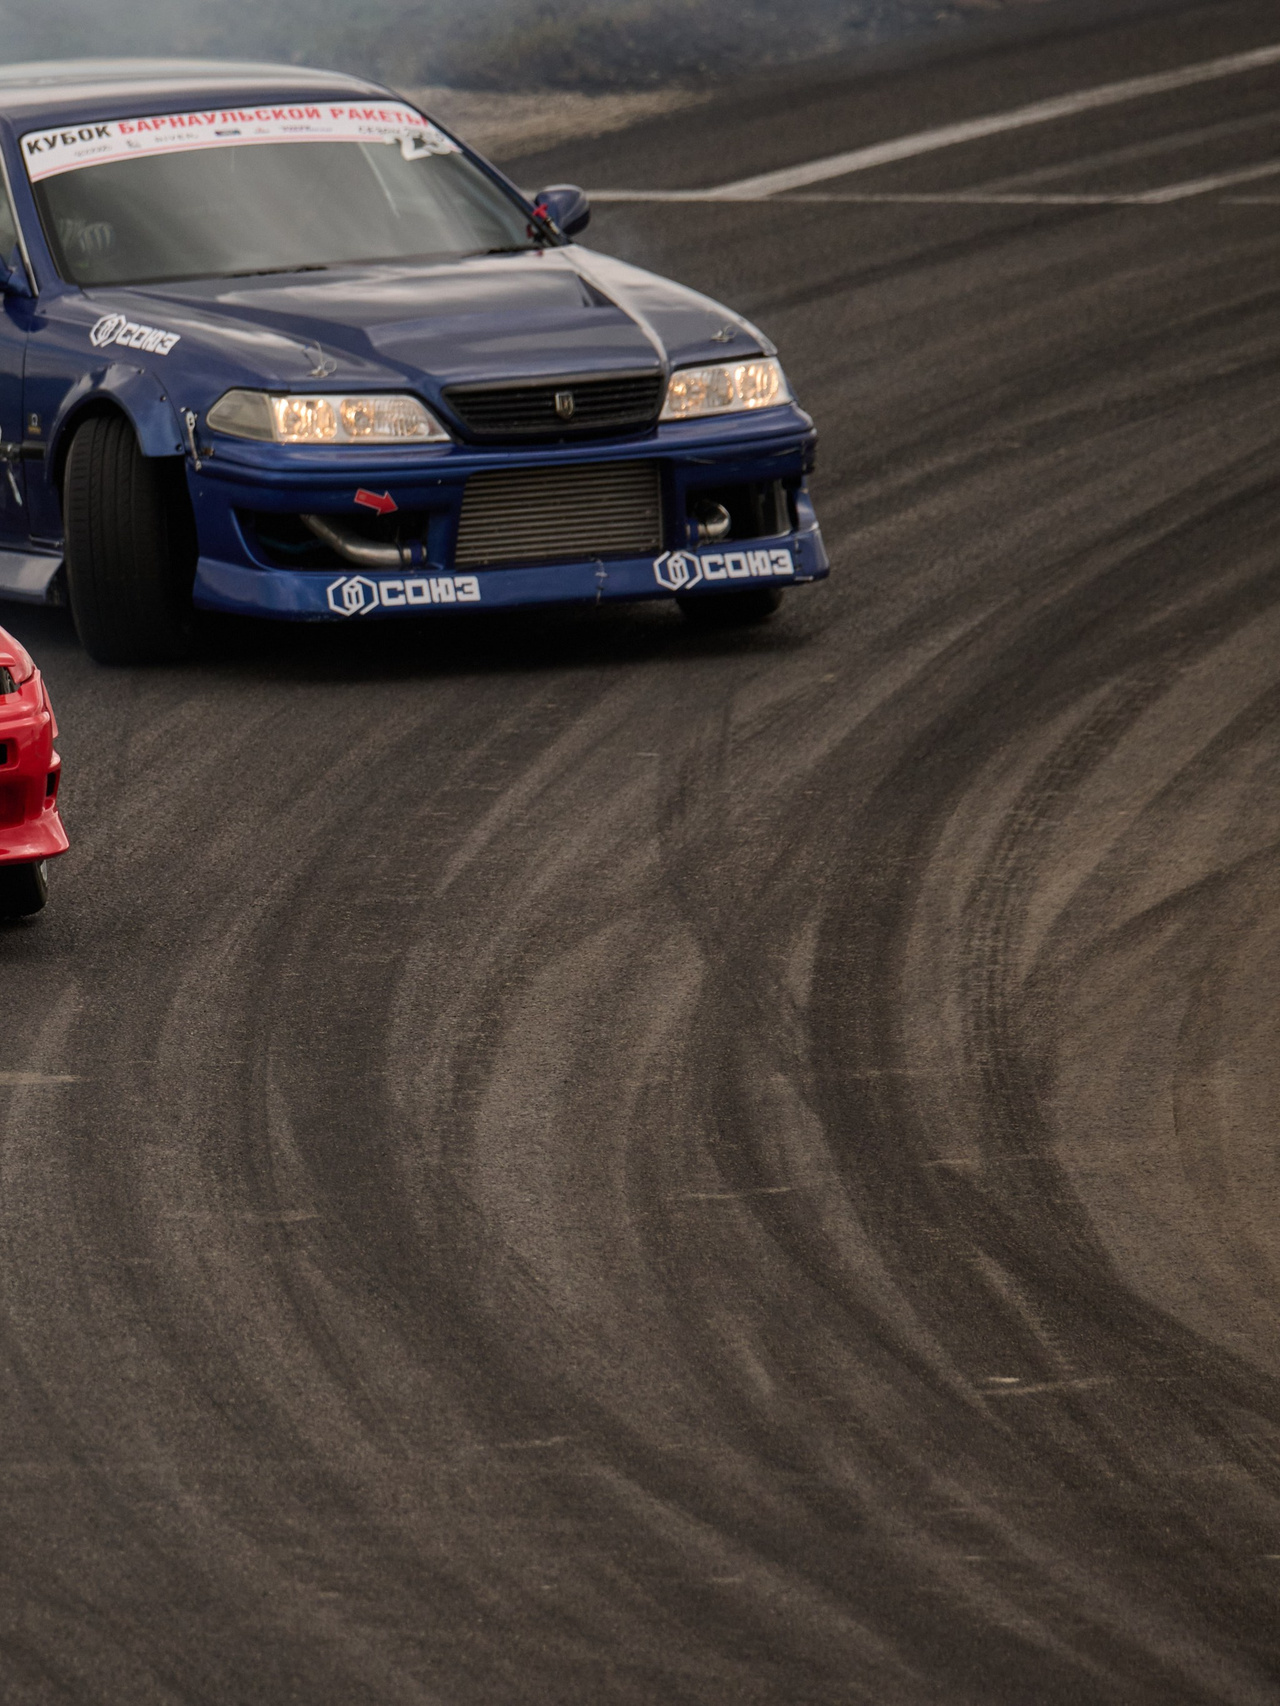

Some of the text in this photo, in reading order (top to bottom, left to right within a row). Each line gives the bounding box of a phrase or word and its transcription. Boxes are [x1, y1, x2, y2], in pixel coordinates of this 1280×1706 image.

[27, 125, 111, 155] КУБОК
[118, 106, 322, 135] БАРНАУЛЬСКОЙ
[330, 107, 428, 127] РАКЕТЫ
[116, 322, 181, 356] СОЮЗ
[700, 548, 794, 581] СОЮЗ
[378, 575, 481, 607] СОЮЗ
